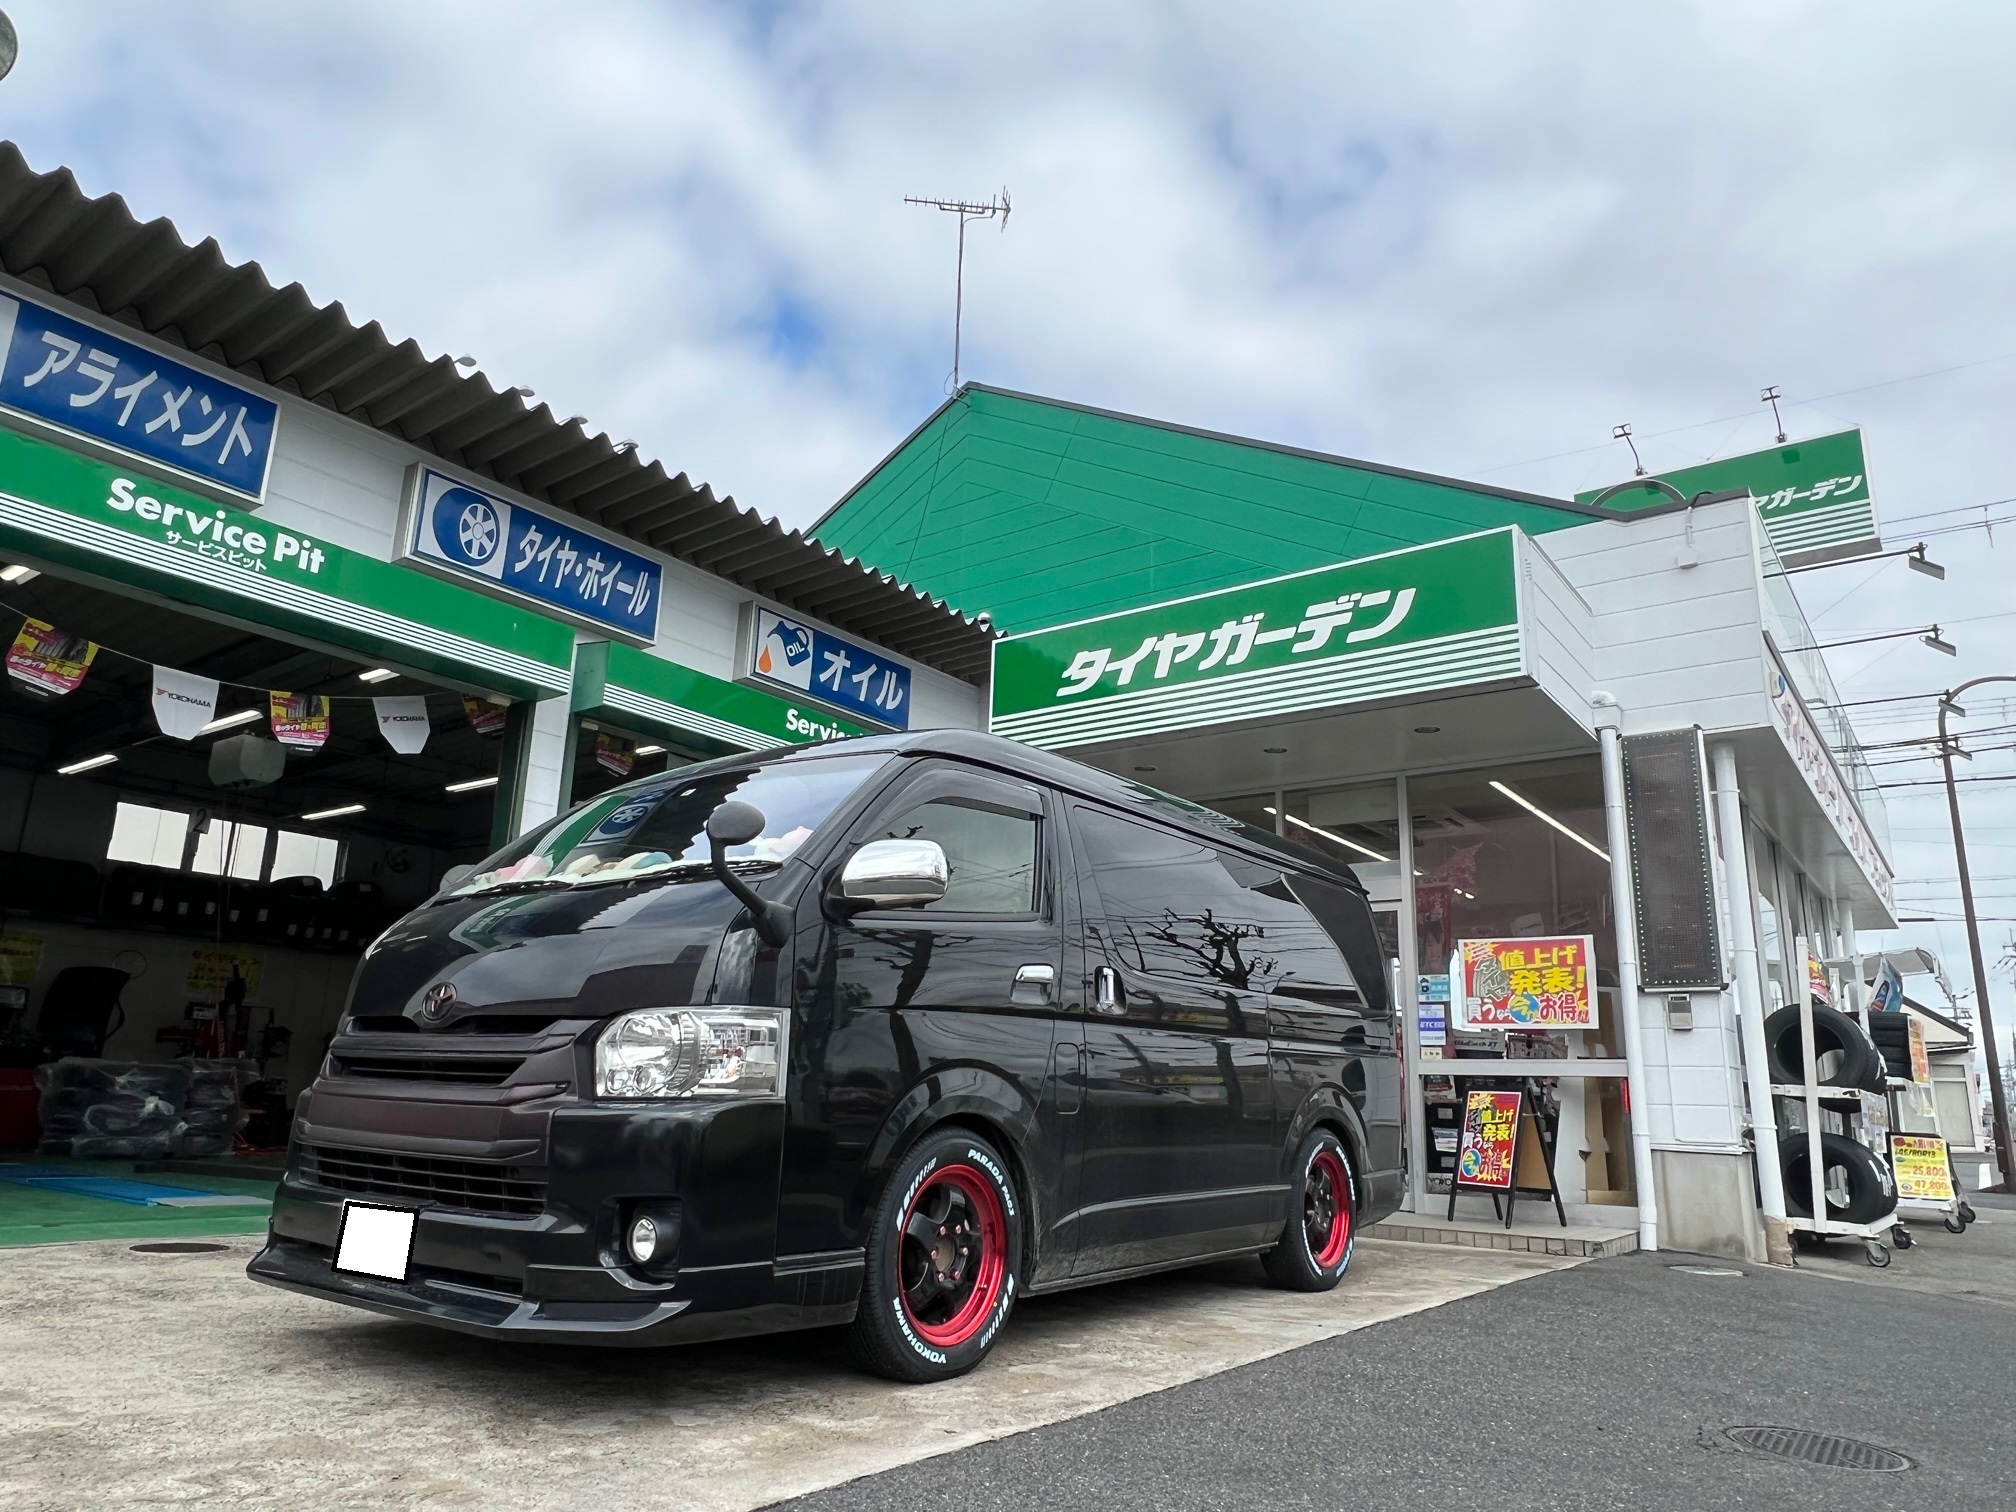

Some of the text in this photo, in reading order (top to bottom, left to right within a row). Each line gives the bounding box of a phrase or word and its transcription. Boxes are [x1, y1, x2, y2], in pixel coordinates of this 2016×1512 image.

[24, 330, 253, 465] アライメント
[106, 477, 325, 574] Service Pit
[514, 524, 651, 617] タイヤ・ホイール
[786, 641, 805, 657] OIL
[1055, 587, 1417, 697] タイヤガーデン
[168, 692, 212, 708] YOKOHAMA
[818, 650, 904, 710] オイル
[785, 708, 852, 741] Servi
[1474, 956, 1511, 1002] タイヤ
[1498, 944, 1578, 971] 値上げ
[967, 1149, 1004, 1185] PARADA
[892, 1297, 947, 1364] YOKOHAMA
